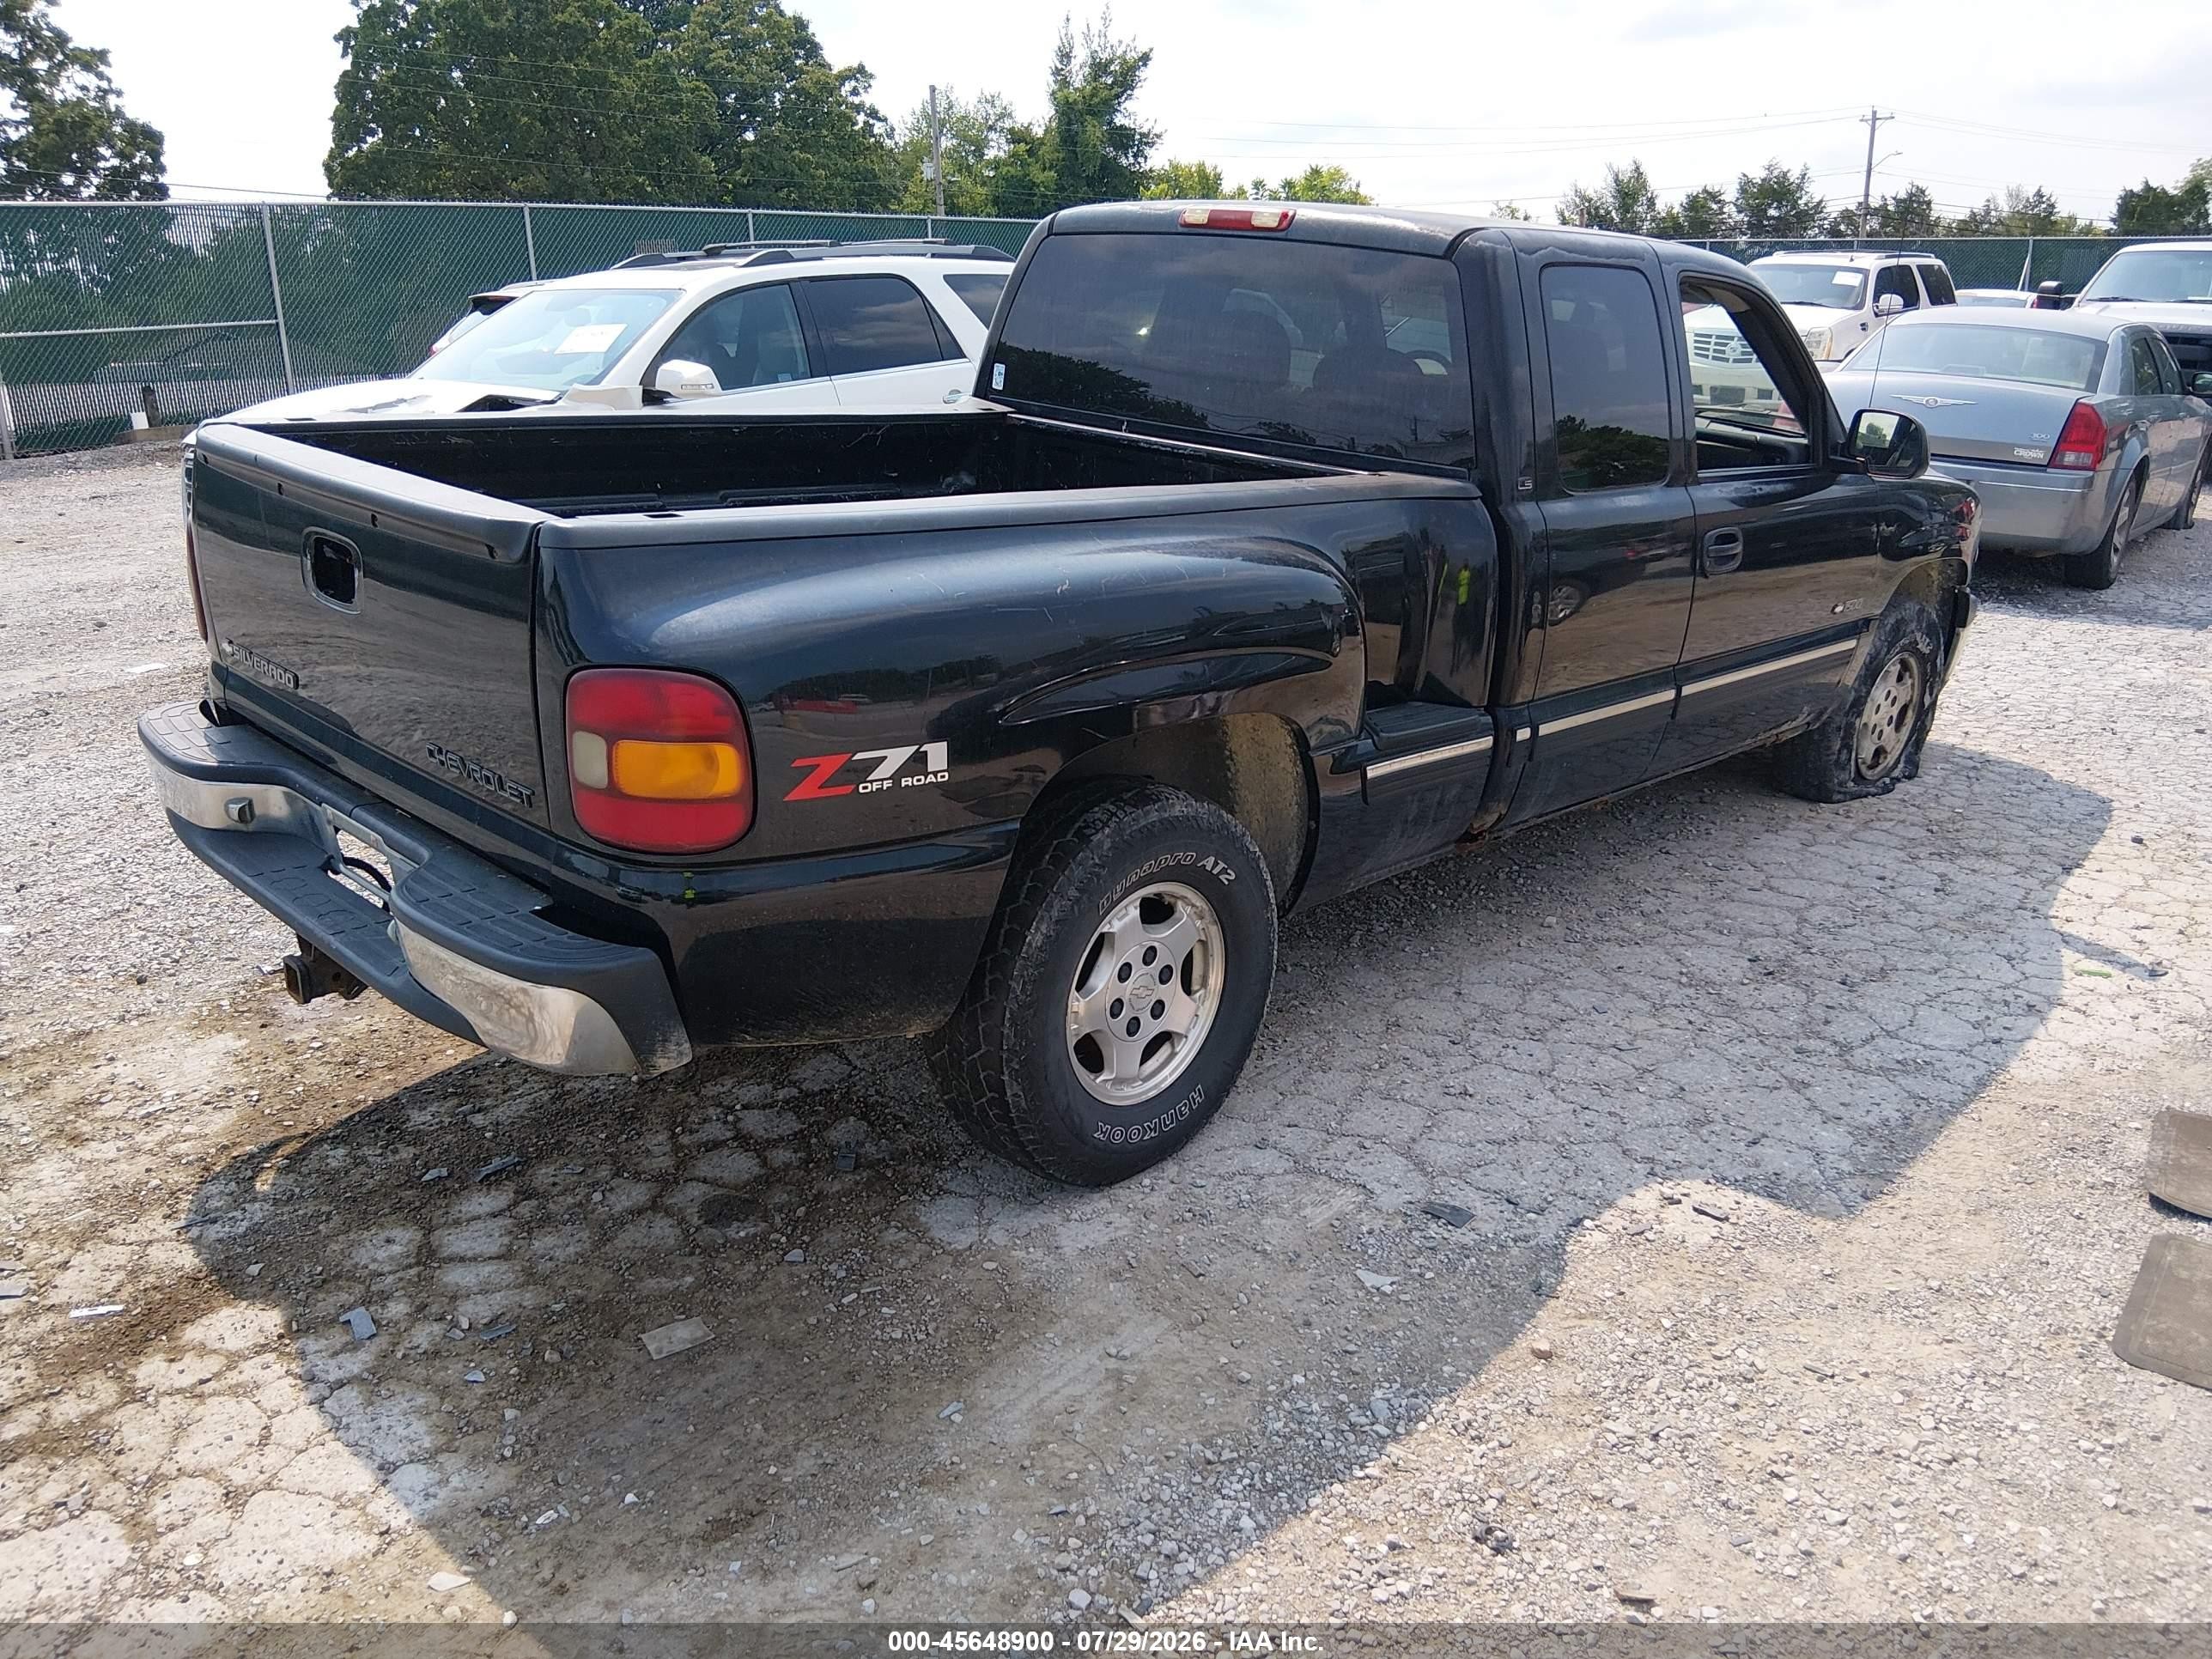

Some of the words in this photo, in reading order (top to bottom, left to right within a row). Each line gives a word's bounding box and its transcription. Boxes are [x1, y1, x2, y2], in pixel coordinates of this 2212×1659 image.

[233, 645, 295, 689] SILVERADO
[426, 742, 535, 808] CHEVROLET
[782, 740, 949, 801] Z71
[858, 779, 893, 794] OFF
[901, 771, 950, 788] ROAD
[1197, 855, 1237, 885] AT2
